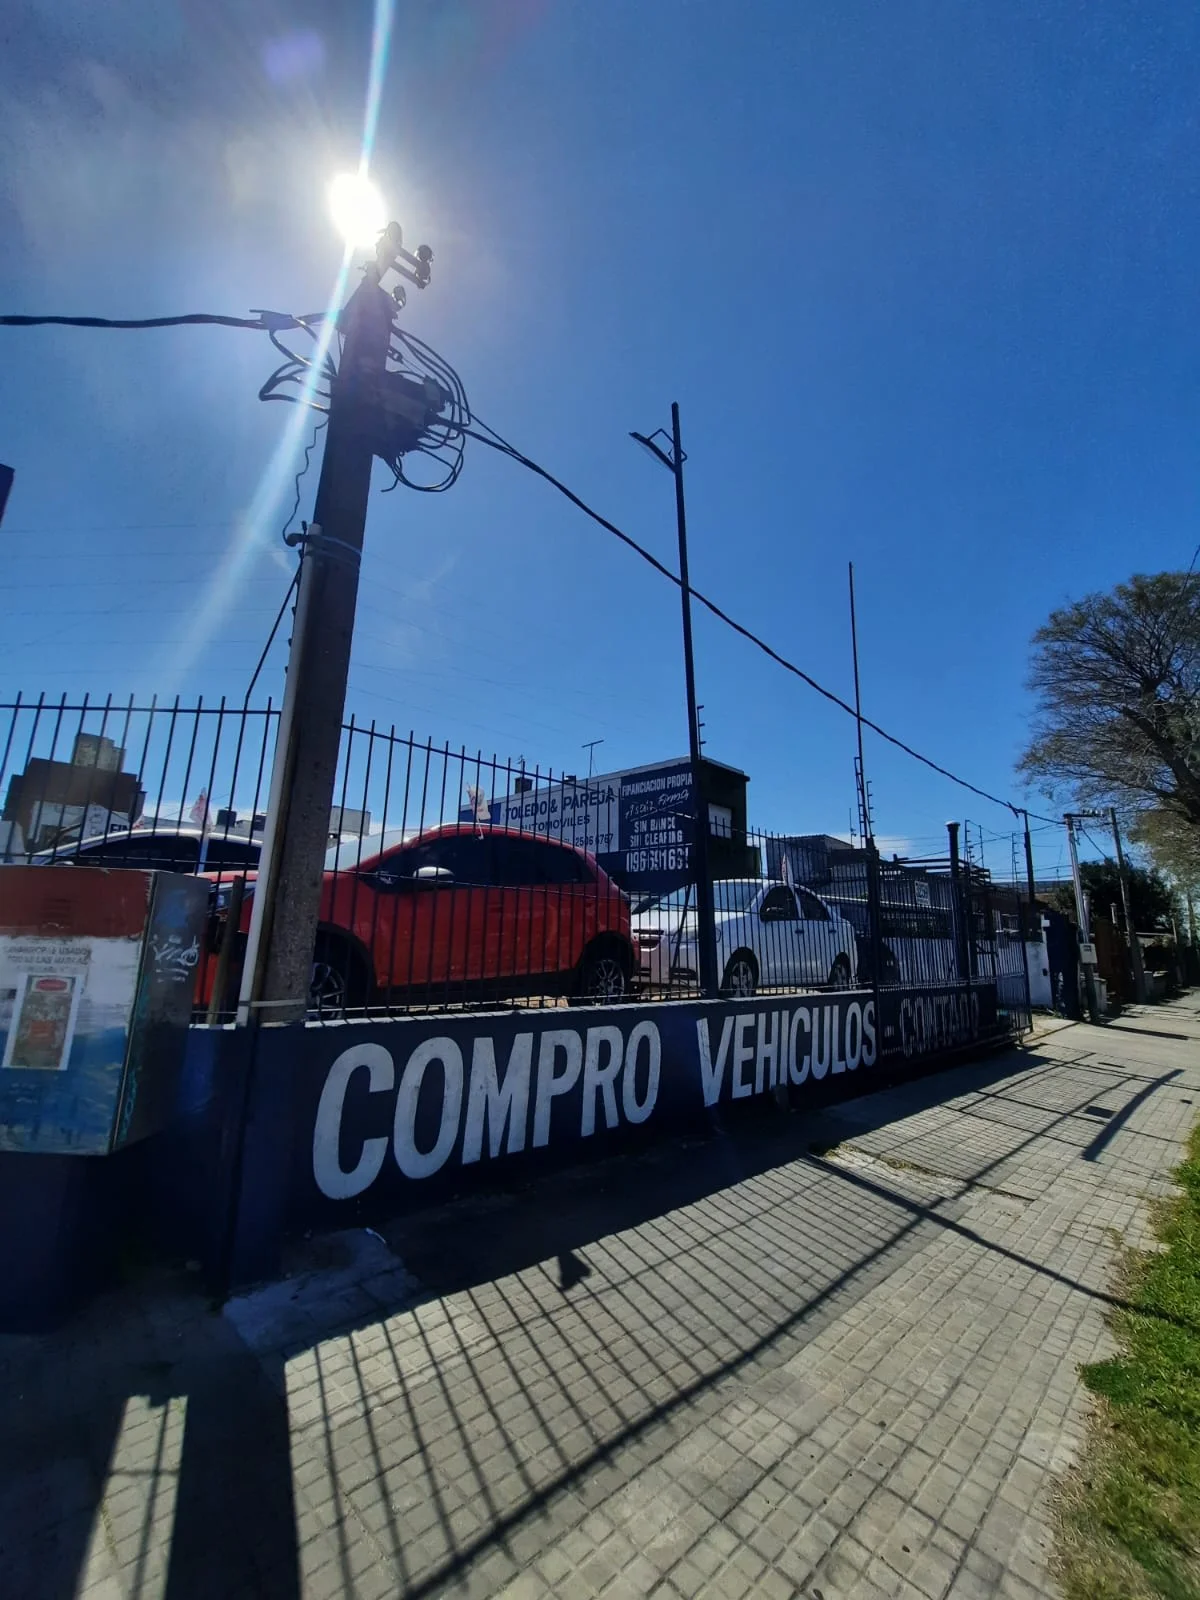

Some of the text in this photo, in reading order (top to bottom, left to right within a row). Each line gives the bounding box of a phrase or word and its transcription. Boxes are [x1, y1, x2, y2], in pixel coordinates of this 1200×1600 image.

[622, 772, 693, 796] FINANCIACION PROPIA
[505, 788, 615, 820] TOLEDO & PAREJA
[634, 816, 676, 833] SIN BANCO
[312, 1020, 661, 1200] COMPRO
[697, 1000, 876, 1107] VEHICULOS
